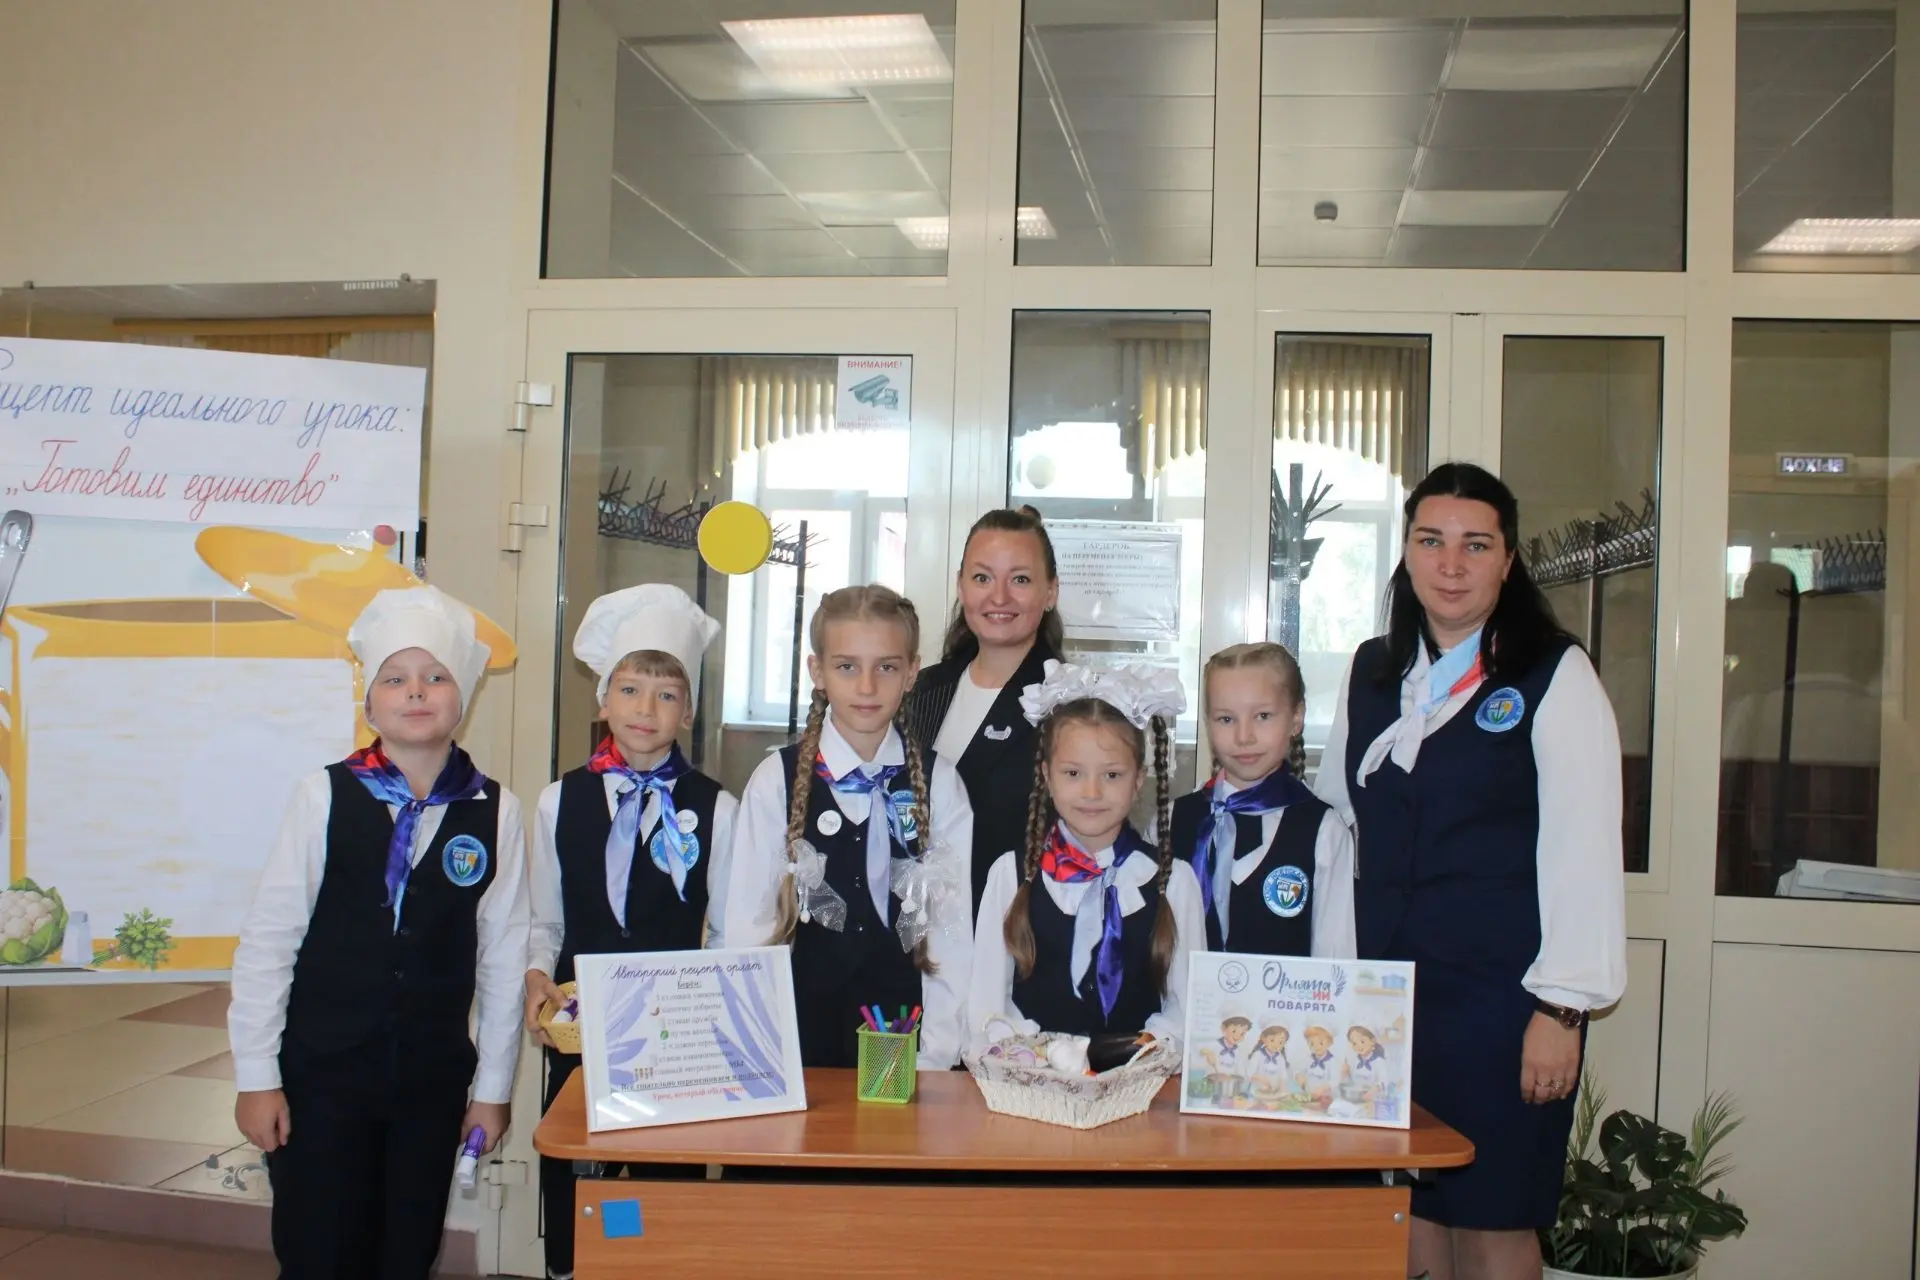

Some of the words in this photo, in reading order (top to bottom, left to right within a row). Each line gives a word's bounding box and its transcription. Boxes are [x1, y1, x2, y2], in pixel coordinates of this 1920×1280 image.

[847, 360, 903, 369] ВНИМАНИЕ!
[110, 384, 286, 439] идеального
[297, 400, 411, 449] урока:
[609, 964, 678, 983] Авторский
[677, 963, 723, 984] рецепт
[726, 959, 763, 977] орлят
[1262, 960, 1332, 994] Орлята
[1267, 999, 1337, 1013] ПОВАРЯТА
